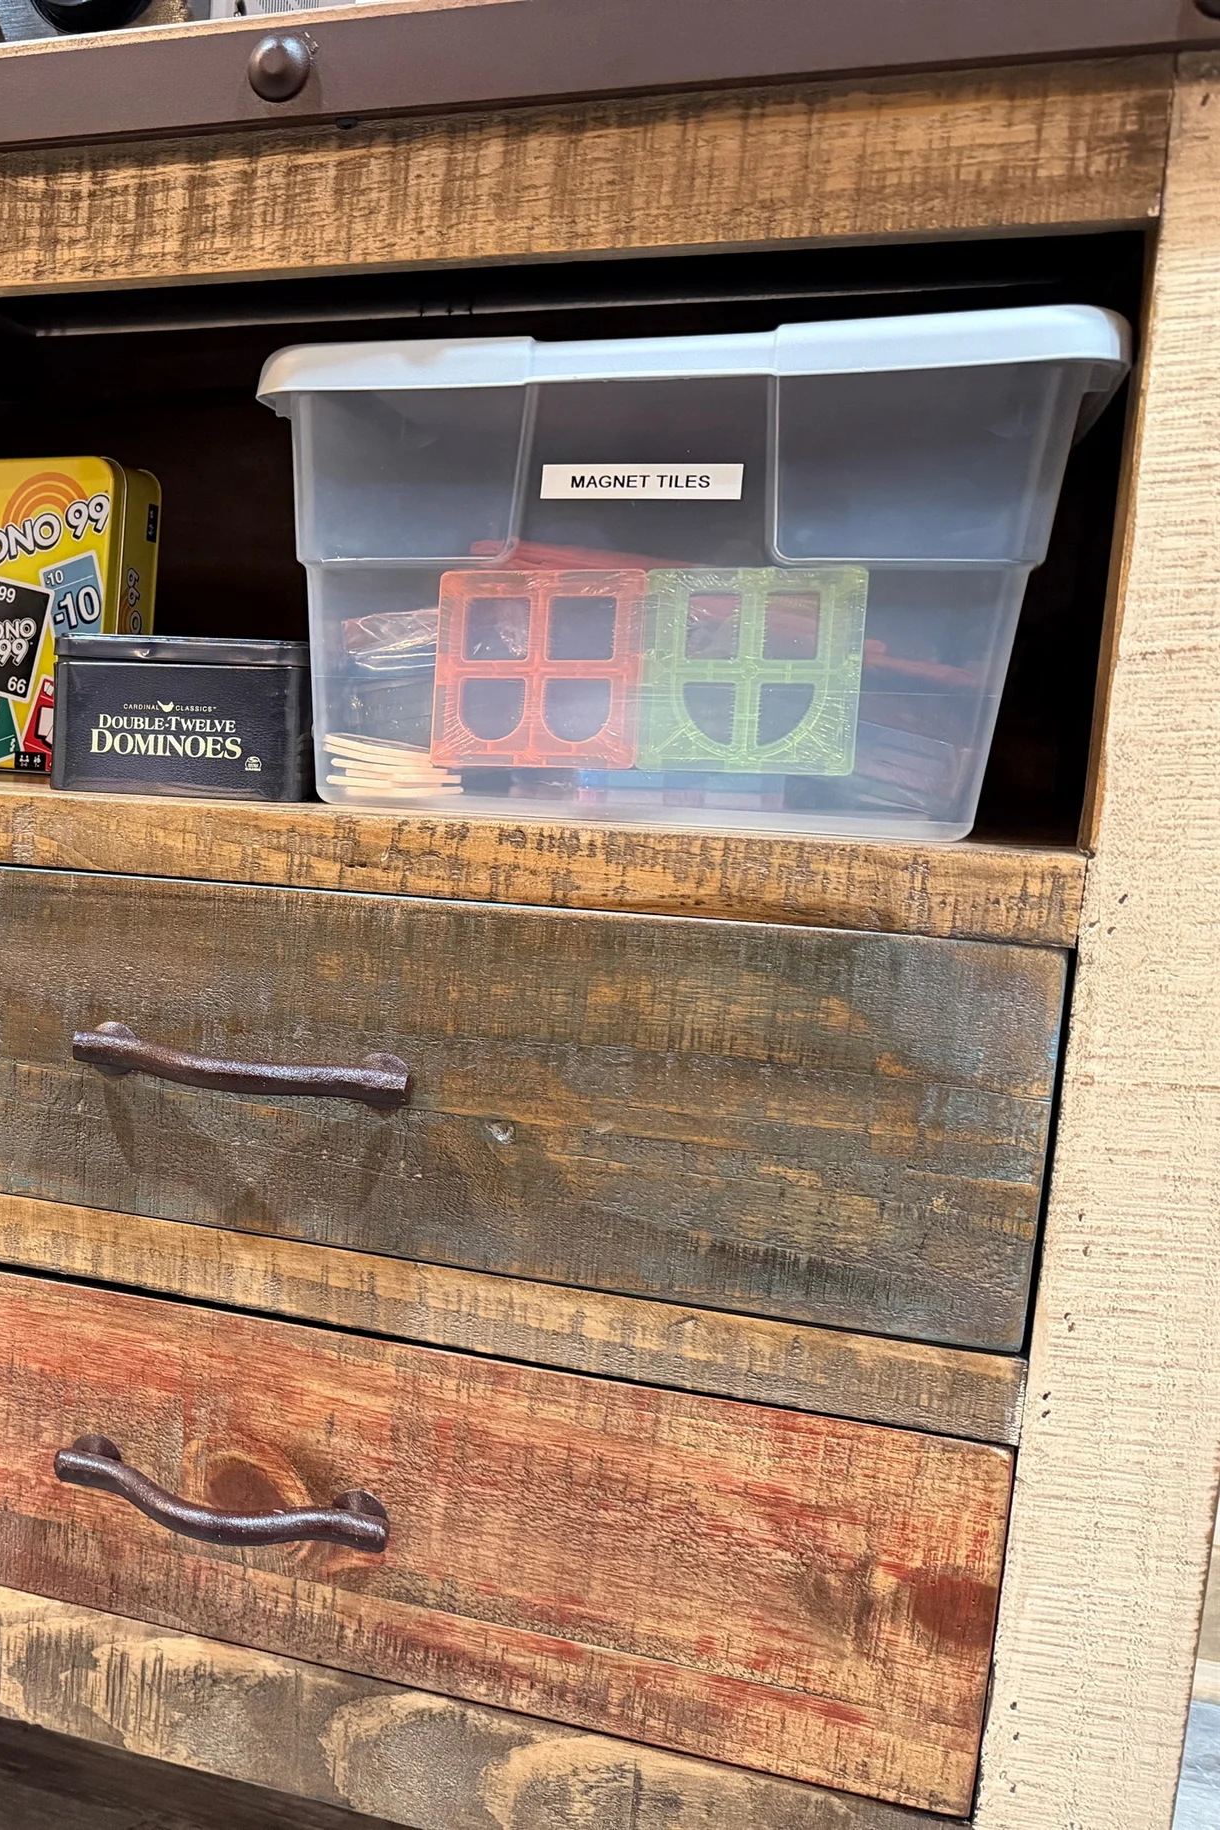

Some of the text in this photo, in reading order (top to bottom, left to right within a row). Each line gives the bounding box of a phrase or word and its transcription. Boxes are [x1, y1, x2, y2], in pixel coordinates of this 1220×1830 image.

[570, 475, 711, 488] MAGNET TILES
[65, 494, 110, 539] 99
[46, 570, 64, 586] -10
[54, 585, 100, 630] -10
[7, 676, 26, 693] 66
[123, 703, 159, 711] CARDINAL
[99, 714, 236, 733] DOUBLE-TWELVE
[90, 728, 242, 760] DOMINOES
